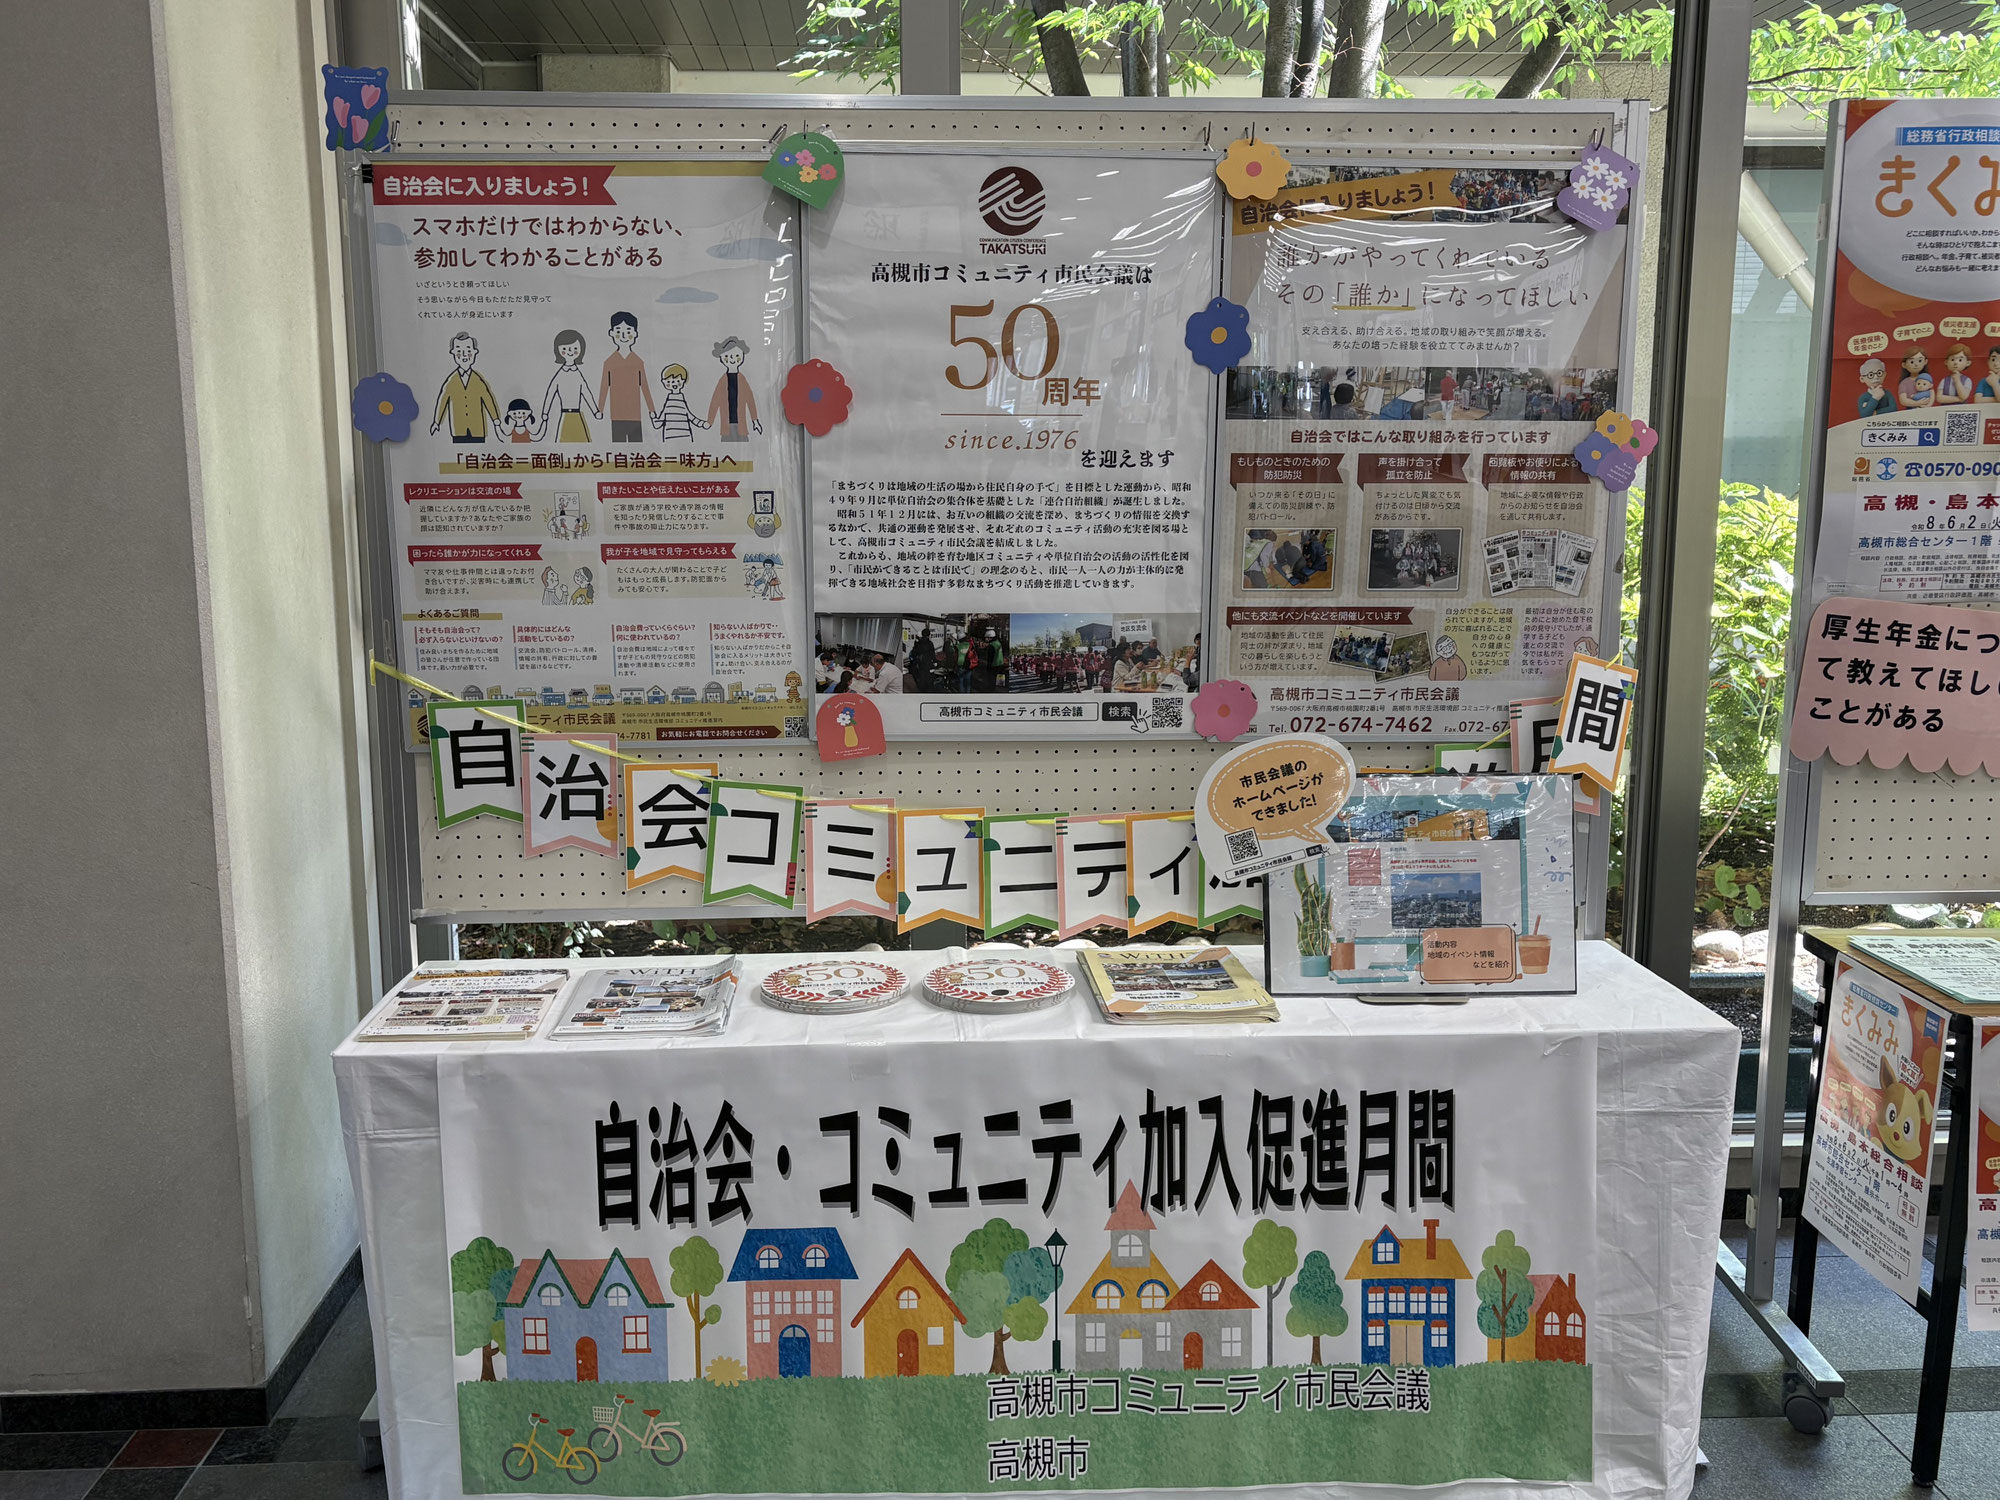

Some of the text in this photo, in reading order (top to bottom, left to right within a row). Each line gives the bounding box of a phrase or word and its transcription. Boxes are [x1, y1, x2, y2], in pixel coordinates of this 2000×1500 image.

[383, 175, 589, 197] 自治会に入りましょう！
[413, 216, 683, 236] スマホだけではわからない、
[980, 244, 1046, 254] TAKATSUKI
[414, 247, 663, 269] 参加してわかることがある
[1277, 246, 1550, 270] 誰かがやってくれている
[872, 263, 1152, 284] 高槻市コミュニティ市民会議は
[416, 280, 509, 288] いざというとき頼ってほしい
[417, 294, 552, 304] そう思いながら今日もただただ見守って
[1278, 282, 1589, 308] その「誰か」になってほしい
[417, 310, 514, 319] くれている人が身近にいます
[1302, 326, 1547, 338] 支え合える、助け合える。地域の取り組みで笑顔が増える。
[1897, 327, 1932, 337] 子育てのこと
[945, 429, 1079, 451] since.1976
[1291, 430, 1551, 444] 自治会ではこんな取り組みを行っています
[1868, 433, 1907, 442] きくみみ
[456, 453, 737, 469] 「自治会＝面倒」から「自治会＝味方」へ
[1081, 450, 1174, 469] を迎えます
[1237, 457, 1330, 466] もしものときのための
[1378, 457, 1442, 467] 声を掛け合って
[1489, 457, 1578, 467] 回覧板やお便りによる
[1264, 470, 1302, 480] 防犯防災
[1386, 470, 1432, 480] 孤立を防止
[1510, 471, 1556, 481] 情報の共有
[409, 487, 511, 495] レクリエーションは交流の場
[603, 485, 730, 494] 聞きたいことや伝えたいことがある
[1376, 490, 1461, 499] ちょっとした異変でも気
[1375, 501, 1461, 511] 付けるのは日頃から交流
[1500, 502, 1583, 510] からのお知らせを自治会
[1375, 512, 1431, 521] があるからです。
[1500, 513, 1566, 521] を通して共有します。
[413, 549, 531, 557] 困ったら誰かが力になってくれる
[606, 547, 727, 556] 我が子を地域で見守ってもらえる
[418, 609, 479, 618] よくあるご質問
[1232, 611, 1401, 621] 他にも交流イベントなどを開催しています
[1240, 663, 1318, 671] いう方が増えています。
[1818, 657, 2000, 696] て教えてほし
[1270, 687, 1460, 701] 高槻市コミュニティ市民会議
[939, 706, 1083, 718] 高槻市コミュニティ市民会議
[1108, 705, 1131, 717] 検索
[1810, 697, 1944, 733] ことがある
[1269, 724, 1286, 733] Tel.
[1290, 716, 1432, 732] 072-674-7462
[662, 729, 768, 738] お気軽にお電話でお問合せください
[1240, 760, 1307, 789] 市民会議の
[1233, 772, 1323, 809] ホームページが
[1252, 794, 1317, 822] できました！
[1427, 950, 1495, 959] 地域のイベント情報
[1473, 961, 1509, 969] などを紹介
[805, 967, 864, 981] 50
[967, 967, 1025, 980] 50
[1842, 995, 1899, 1055] きくみみ
[595, 1088, 1456, 1229] 自治会・コミュニティ加入促進月間
[986, 1368, 1431, 1420] 高槻市コミュニティ市民会議
[987, 1436, 1090, 1483] 高槻市
